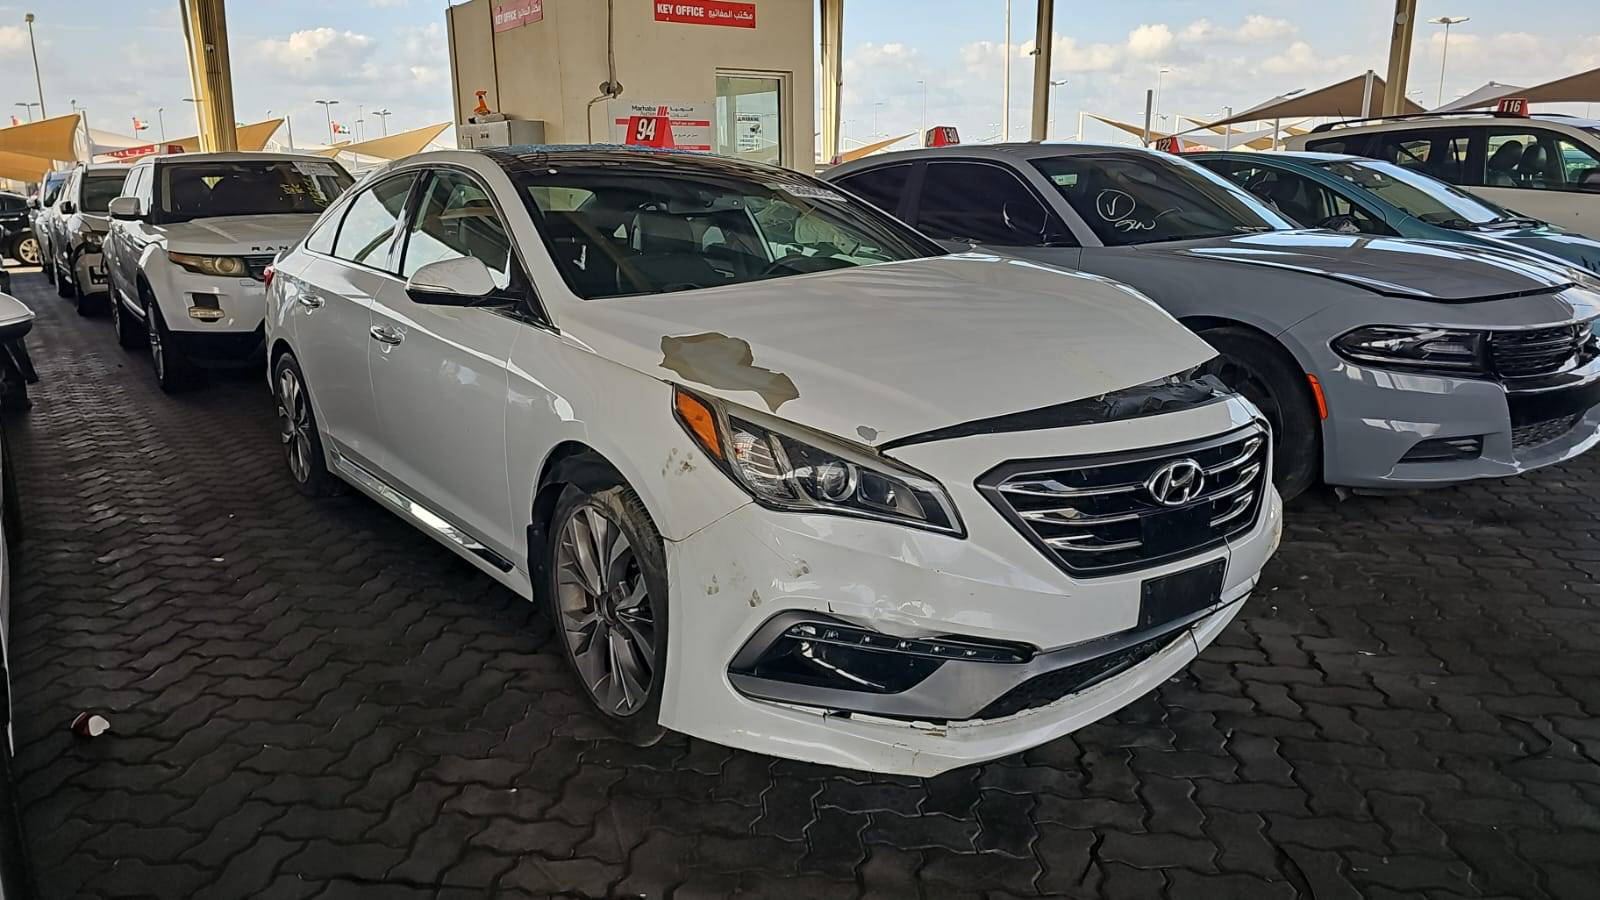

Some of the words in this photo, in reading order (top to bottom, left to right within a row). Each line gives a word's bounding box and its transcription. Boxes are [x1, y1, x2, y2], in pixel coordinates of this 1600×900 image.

[657, 3, 674, 14] KEY
[676, 5, 704, 17] OFFICE
[708, 8, 733, 19] المفاتيح
[733, 10, 754, 20] مكتب
[631, 104, 656, 112] Marhaba
[1503, 100, 1522, 113] 116
[636, 118, 657, 141] 94
[1157, 138, 1172, 151] 122
